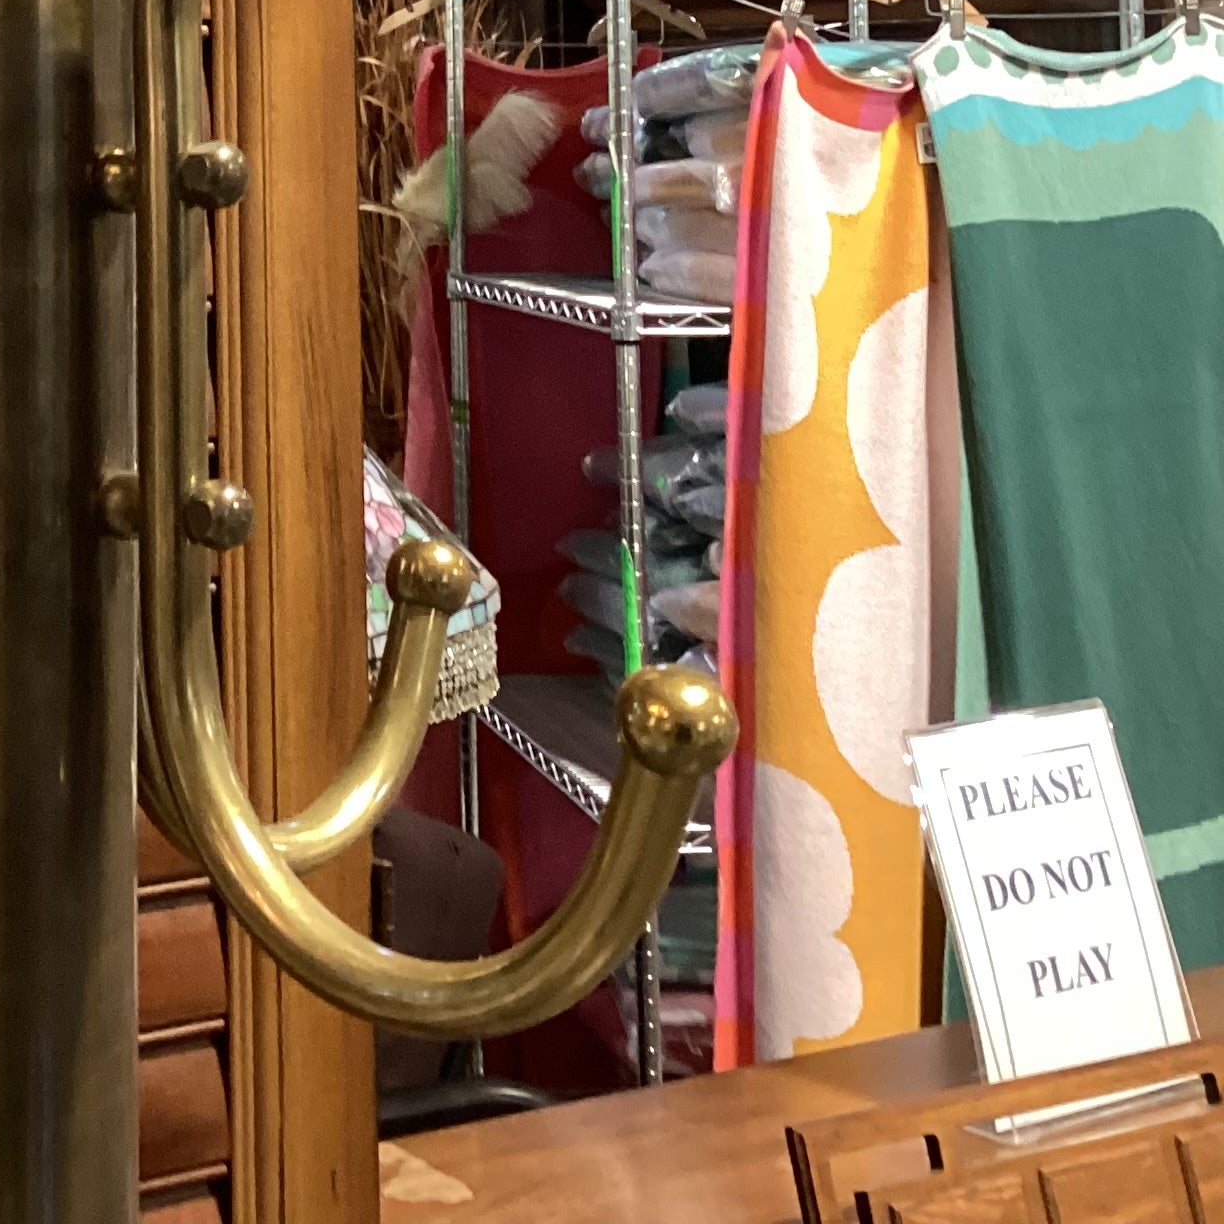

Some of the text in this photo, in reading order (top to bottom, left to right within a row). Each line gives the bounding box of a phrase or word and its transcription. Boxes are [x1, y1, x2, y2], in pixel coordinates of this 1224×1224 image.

[959, 763, 1092, 821] PLEASE
[982, 849, 1113, 912] DO NOT
[1027, 943, 1114, 999] PLAY
